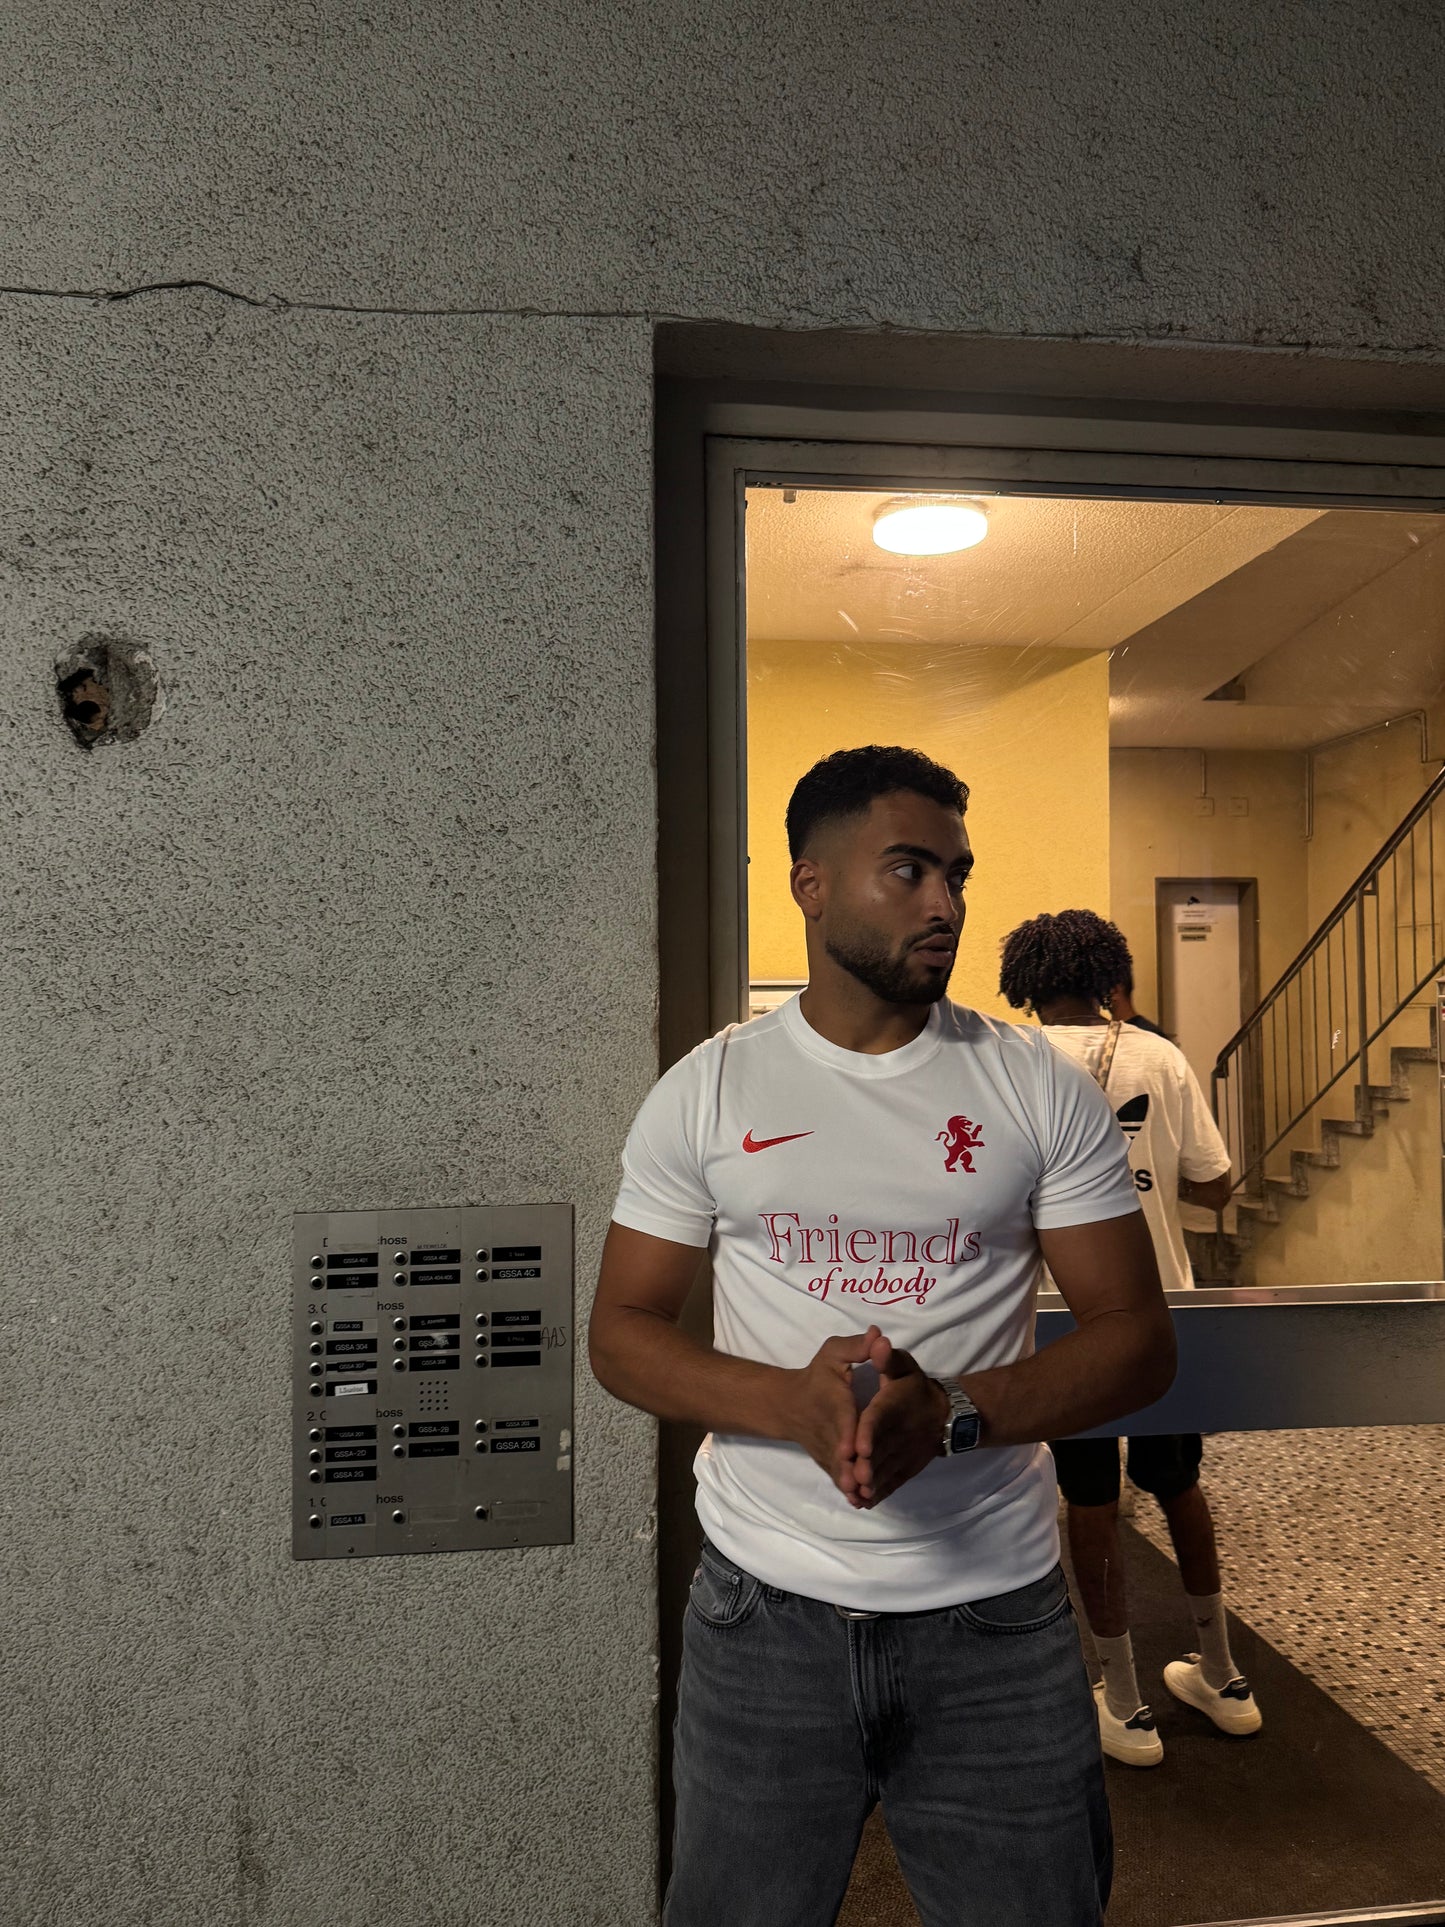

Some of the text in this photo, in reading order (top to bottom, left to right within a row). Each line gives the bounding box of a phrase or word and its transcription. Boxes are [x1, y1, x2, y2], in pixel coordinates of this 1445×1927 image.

[377, 1236, 408, 1246] hoss
[759, 1212, 982, 1265] Friends
[500, 1268, 536, 1279] GSSA 4C
[807, 1266, 937, 1306] of nobody
[307, 1303, 319, 1314] 3.
[355, 1343, 369, 1351] 304
[496, 1439, 537, 1450] GSSA 206
[333, 1470, 353, 1479] GSSA
[375, 1493, 404, 1504] hoss
[332, 1515, 364, 1525] GSSA 1A
